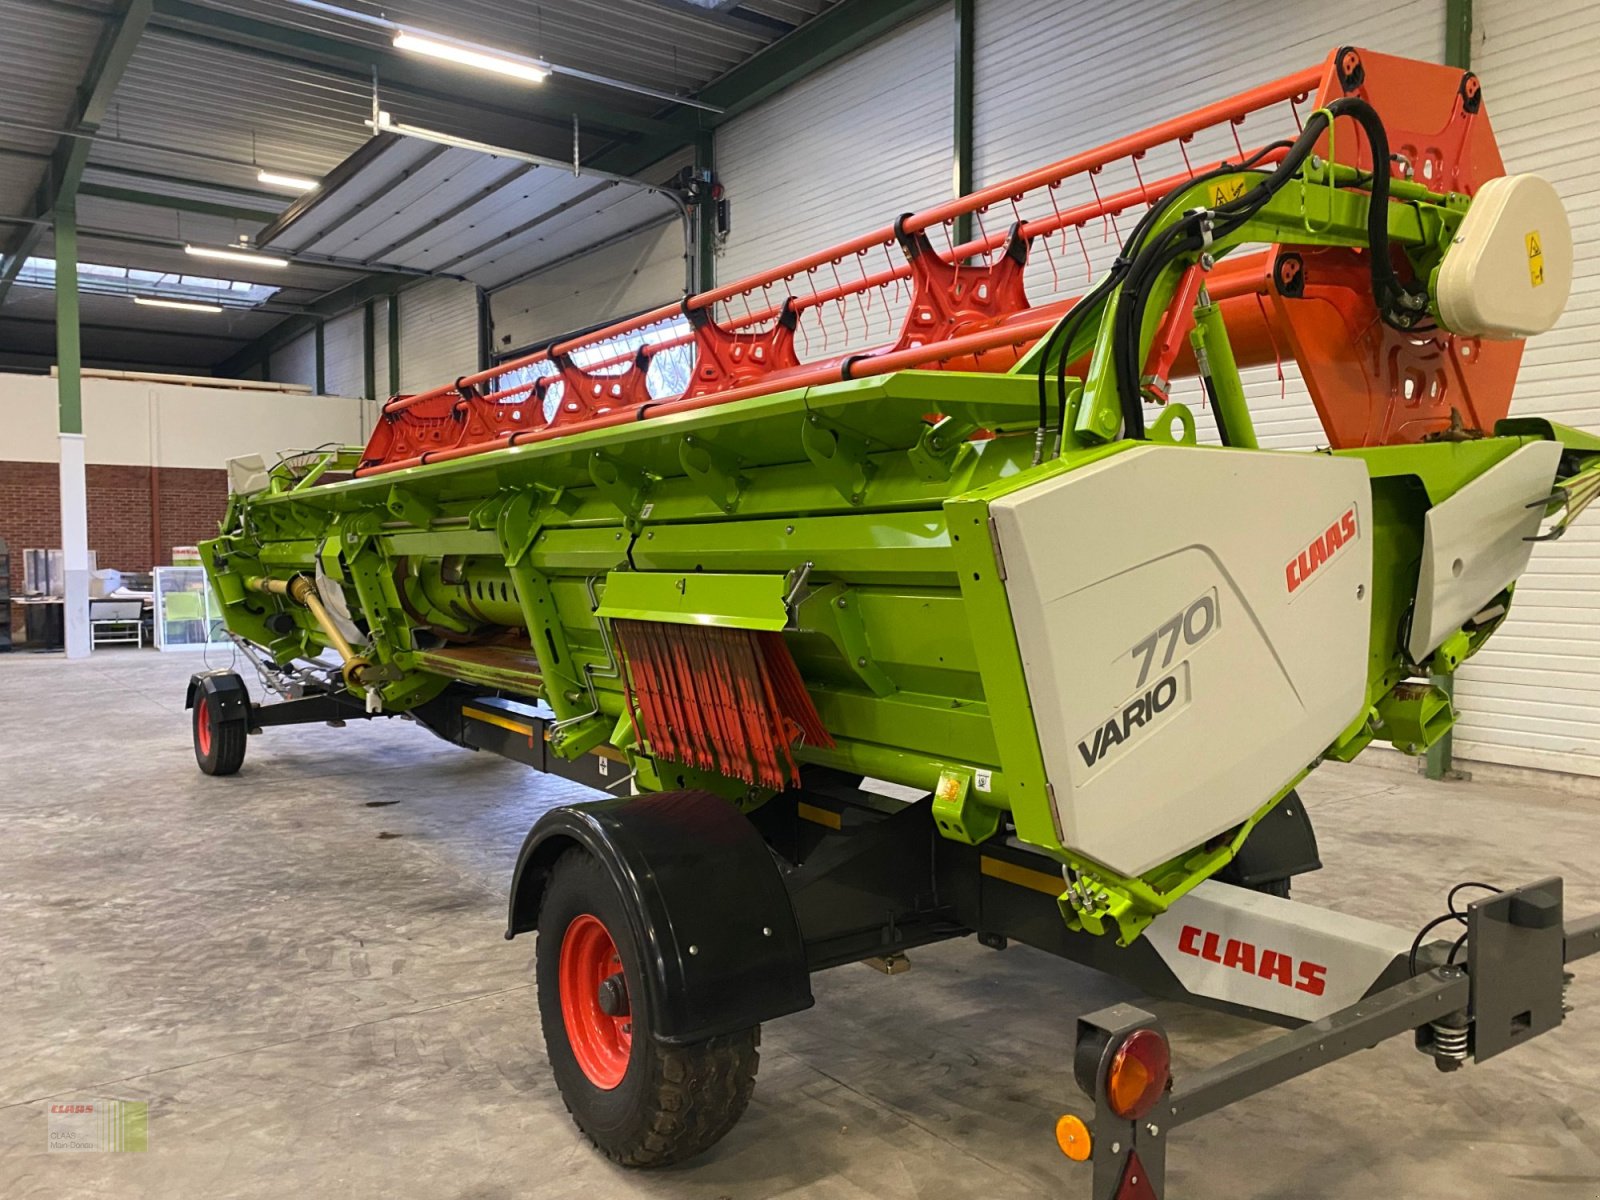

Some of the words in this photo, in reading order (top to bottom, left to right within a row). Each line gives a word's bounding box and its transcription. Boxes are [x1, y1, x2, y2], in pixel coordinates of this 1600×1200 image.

[1286, 509, 1355, 593] CLAAS
[1132, 596, 1214, 689] 770
[1077, 676, 1177, 768] VARIO
[1178, 925, 1327, 996] CLAAS
